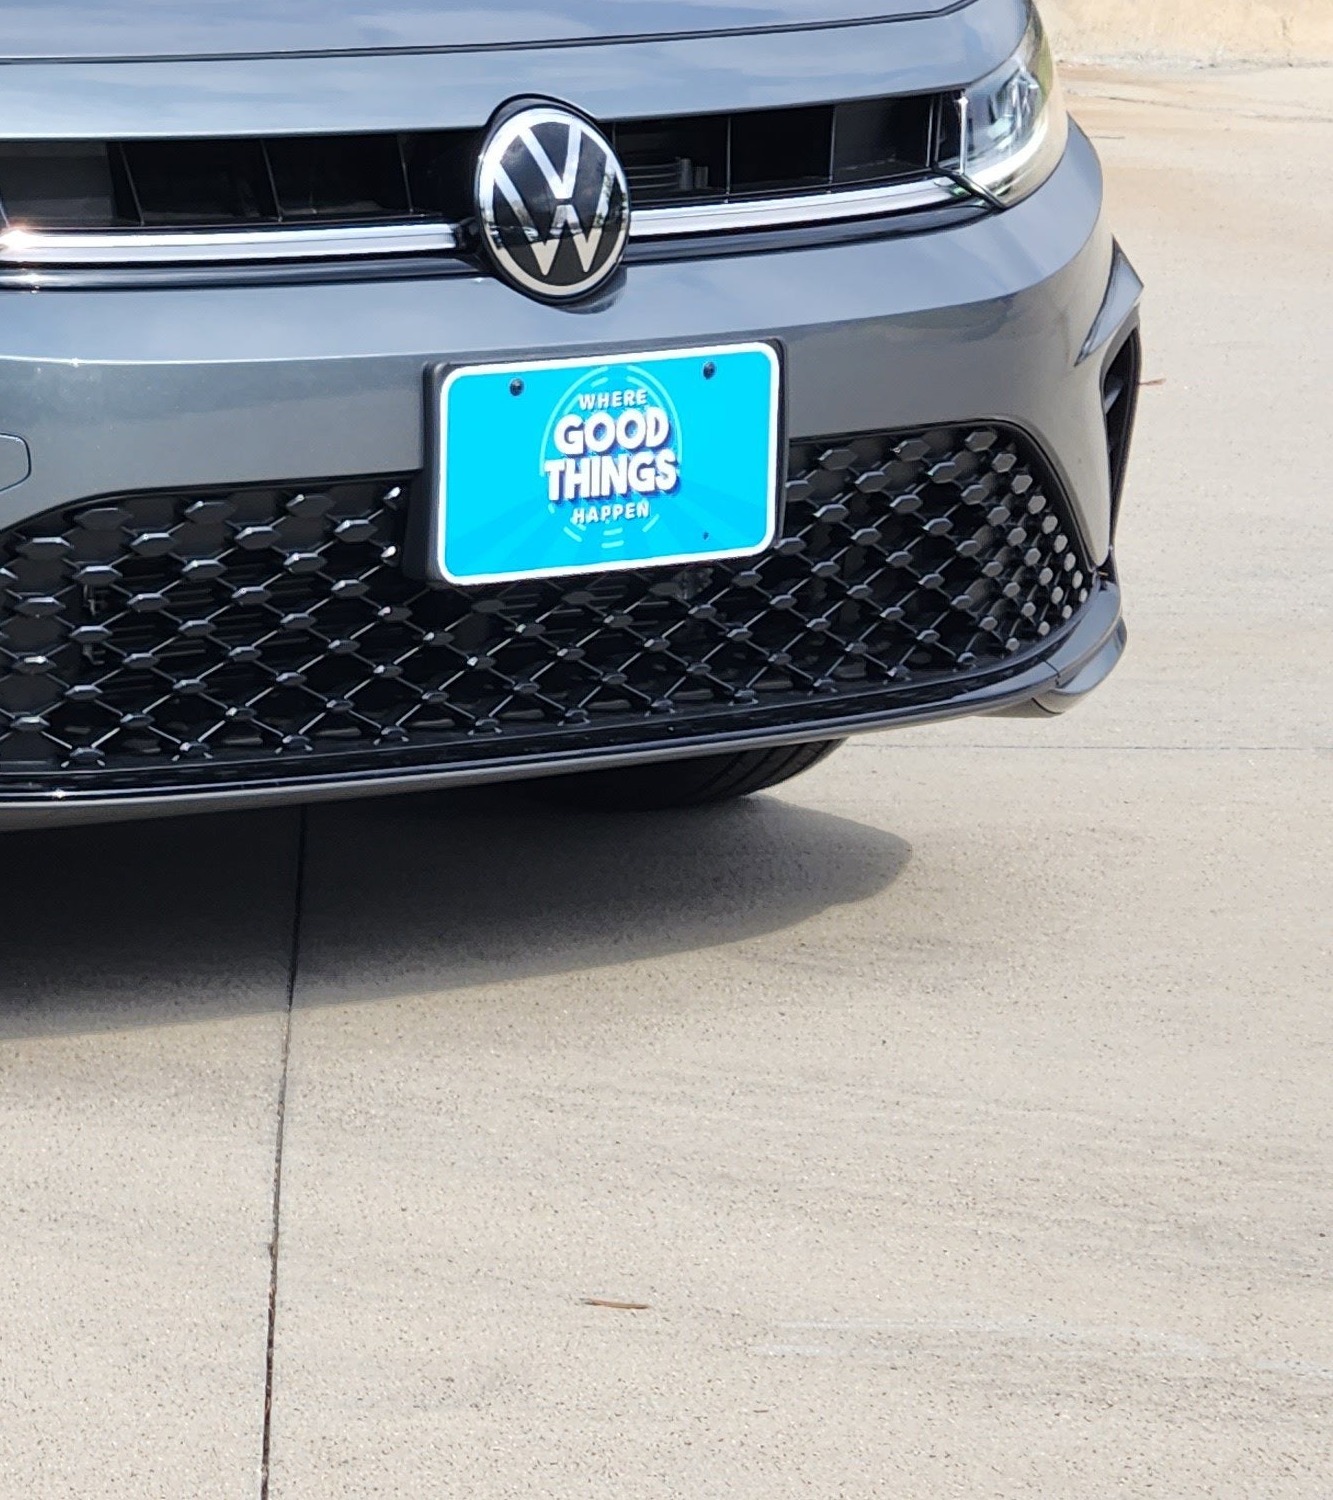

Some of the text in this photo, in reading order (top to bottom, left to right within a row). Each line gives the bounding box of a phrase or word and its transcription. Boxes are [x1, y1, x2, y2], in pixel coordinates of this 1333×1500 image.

[578, 389, 648, 411] WHERE
[553, 406, 670, 456] GOOD
[543, 448, 678, 502] THINGS
[571, 499, 651, 525] HAPPEN
